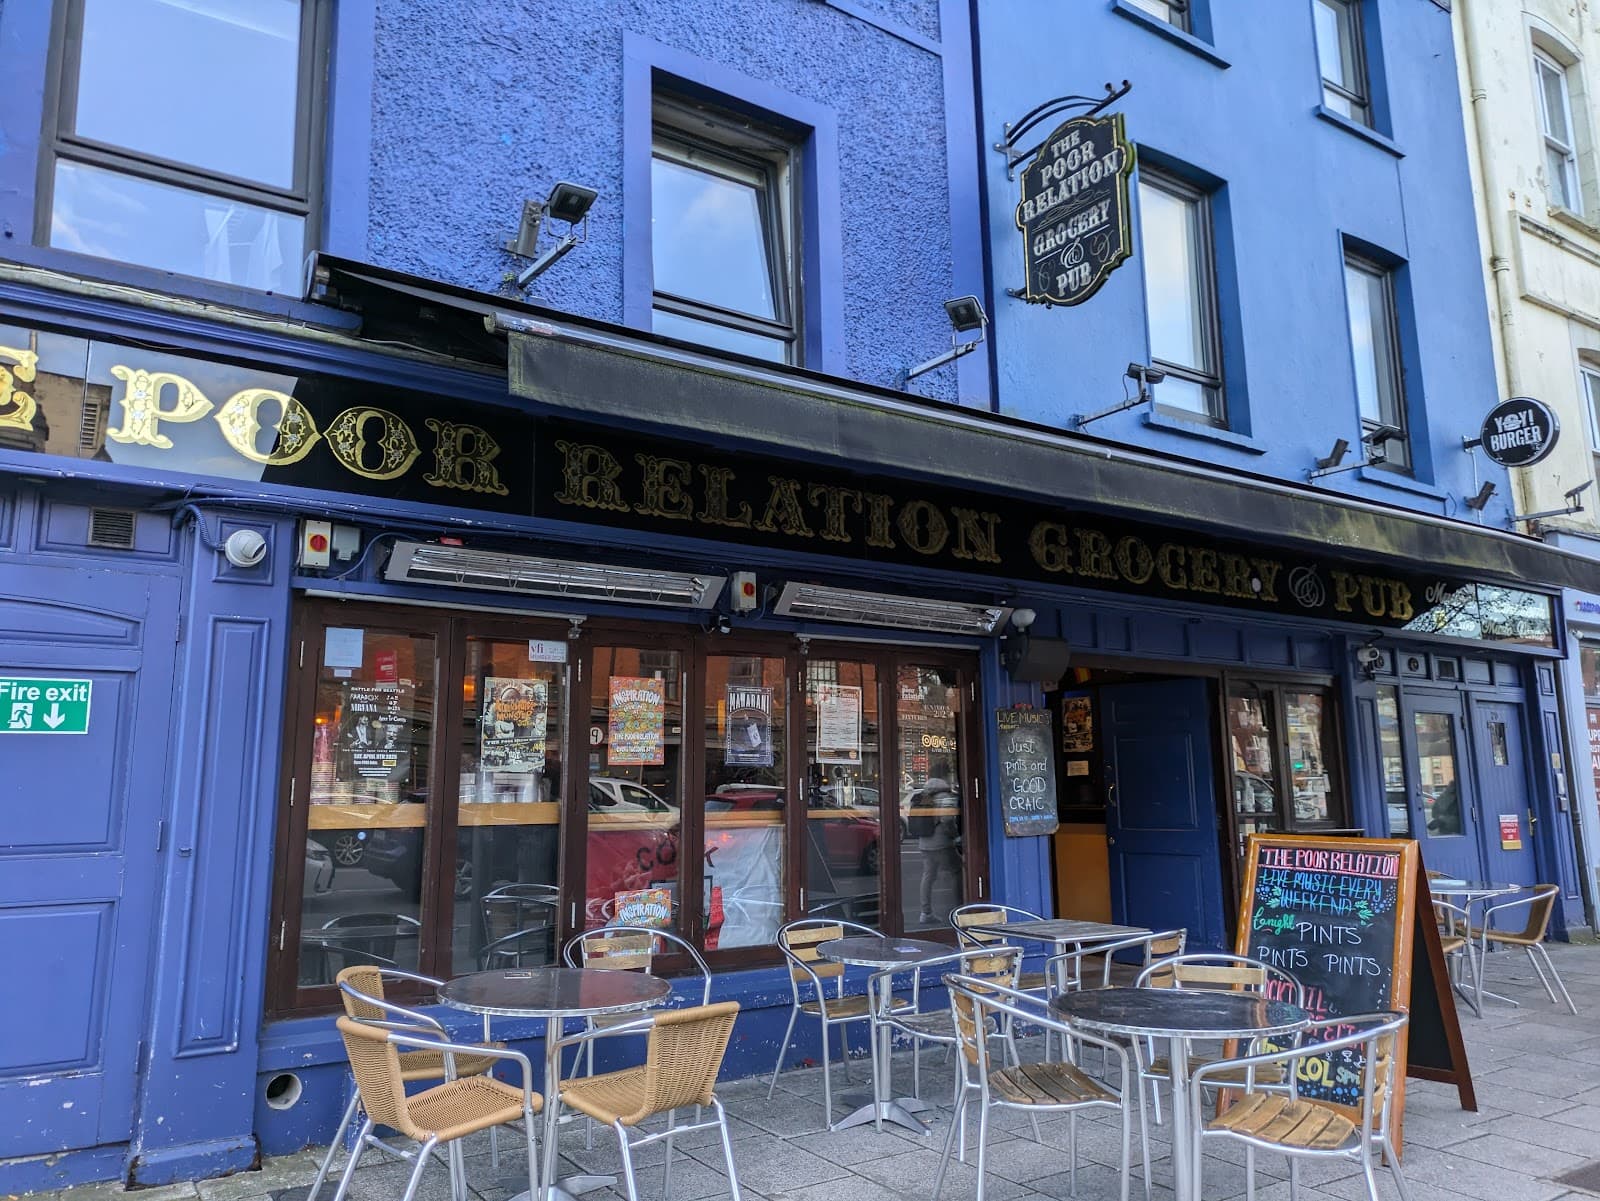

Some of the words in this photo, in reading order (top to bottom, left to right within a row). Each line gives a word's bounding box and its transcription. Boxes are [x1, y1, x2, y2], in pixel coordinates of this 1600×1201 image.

[1051, 129, 1081, 158] THE
[1040, 140, 1096, 188] POOR
[1022, 149, 1120, 223] RELATION
[1033, 198, 1112, 256] GROCERY
[1060, 237, 1085, 269] &
[1056, 261, 1093, 297] PUB
[1490, 426, 1543, 452] BURGER
[106, 364, 510, 497] POOR
[554, 438, 1003, 564] RELATION
[1028, 519, 1285, 603] GROCERY
[1287, 562, 1326, 608] &
[1329, 568, 1415, 621] PUB
[0, 681, 41, 701] Fire
[45, 683, 88, 702] exit
[613, 688, 661, 706] INSPIRATION
[351, 703, 378, 712] NIRVANA
[997, 711, 1018, 724] LIVE
[1007, 738, 1036, 754] Just
[1005, 759, 1028, 775] pints
[1030, 758, 1047, 772] and
[1013, 776, 1047, 794] GOOD
[1009, 796, 1045, 812] CRAIC
[1262, 848, 1294, 866] THE
[1295, 849, 1328, 869] POOR
[1330, 851, 1400, 876] RELATION
[1262, 868, 1291, 888] LIVE
[1293, 871, 1338, 895] MUSIC
[1339, 876, 1383, 902] EVERY
[619, 903, 669, 922] INSPIRATION
[1279, 888, 1353, 916] WEEKEND
[1296, 921, 1363, 945] PINTS
[1257, 946, 1309, 969] PINTS
[1323, 953, 1382, 977] PINTS
